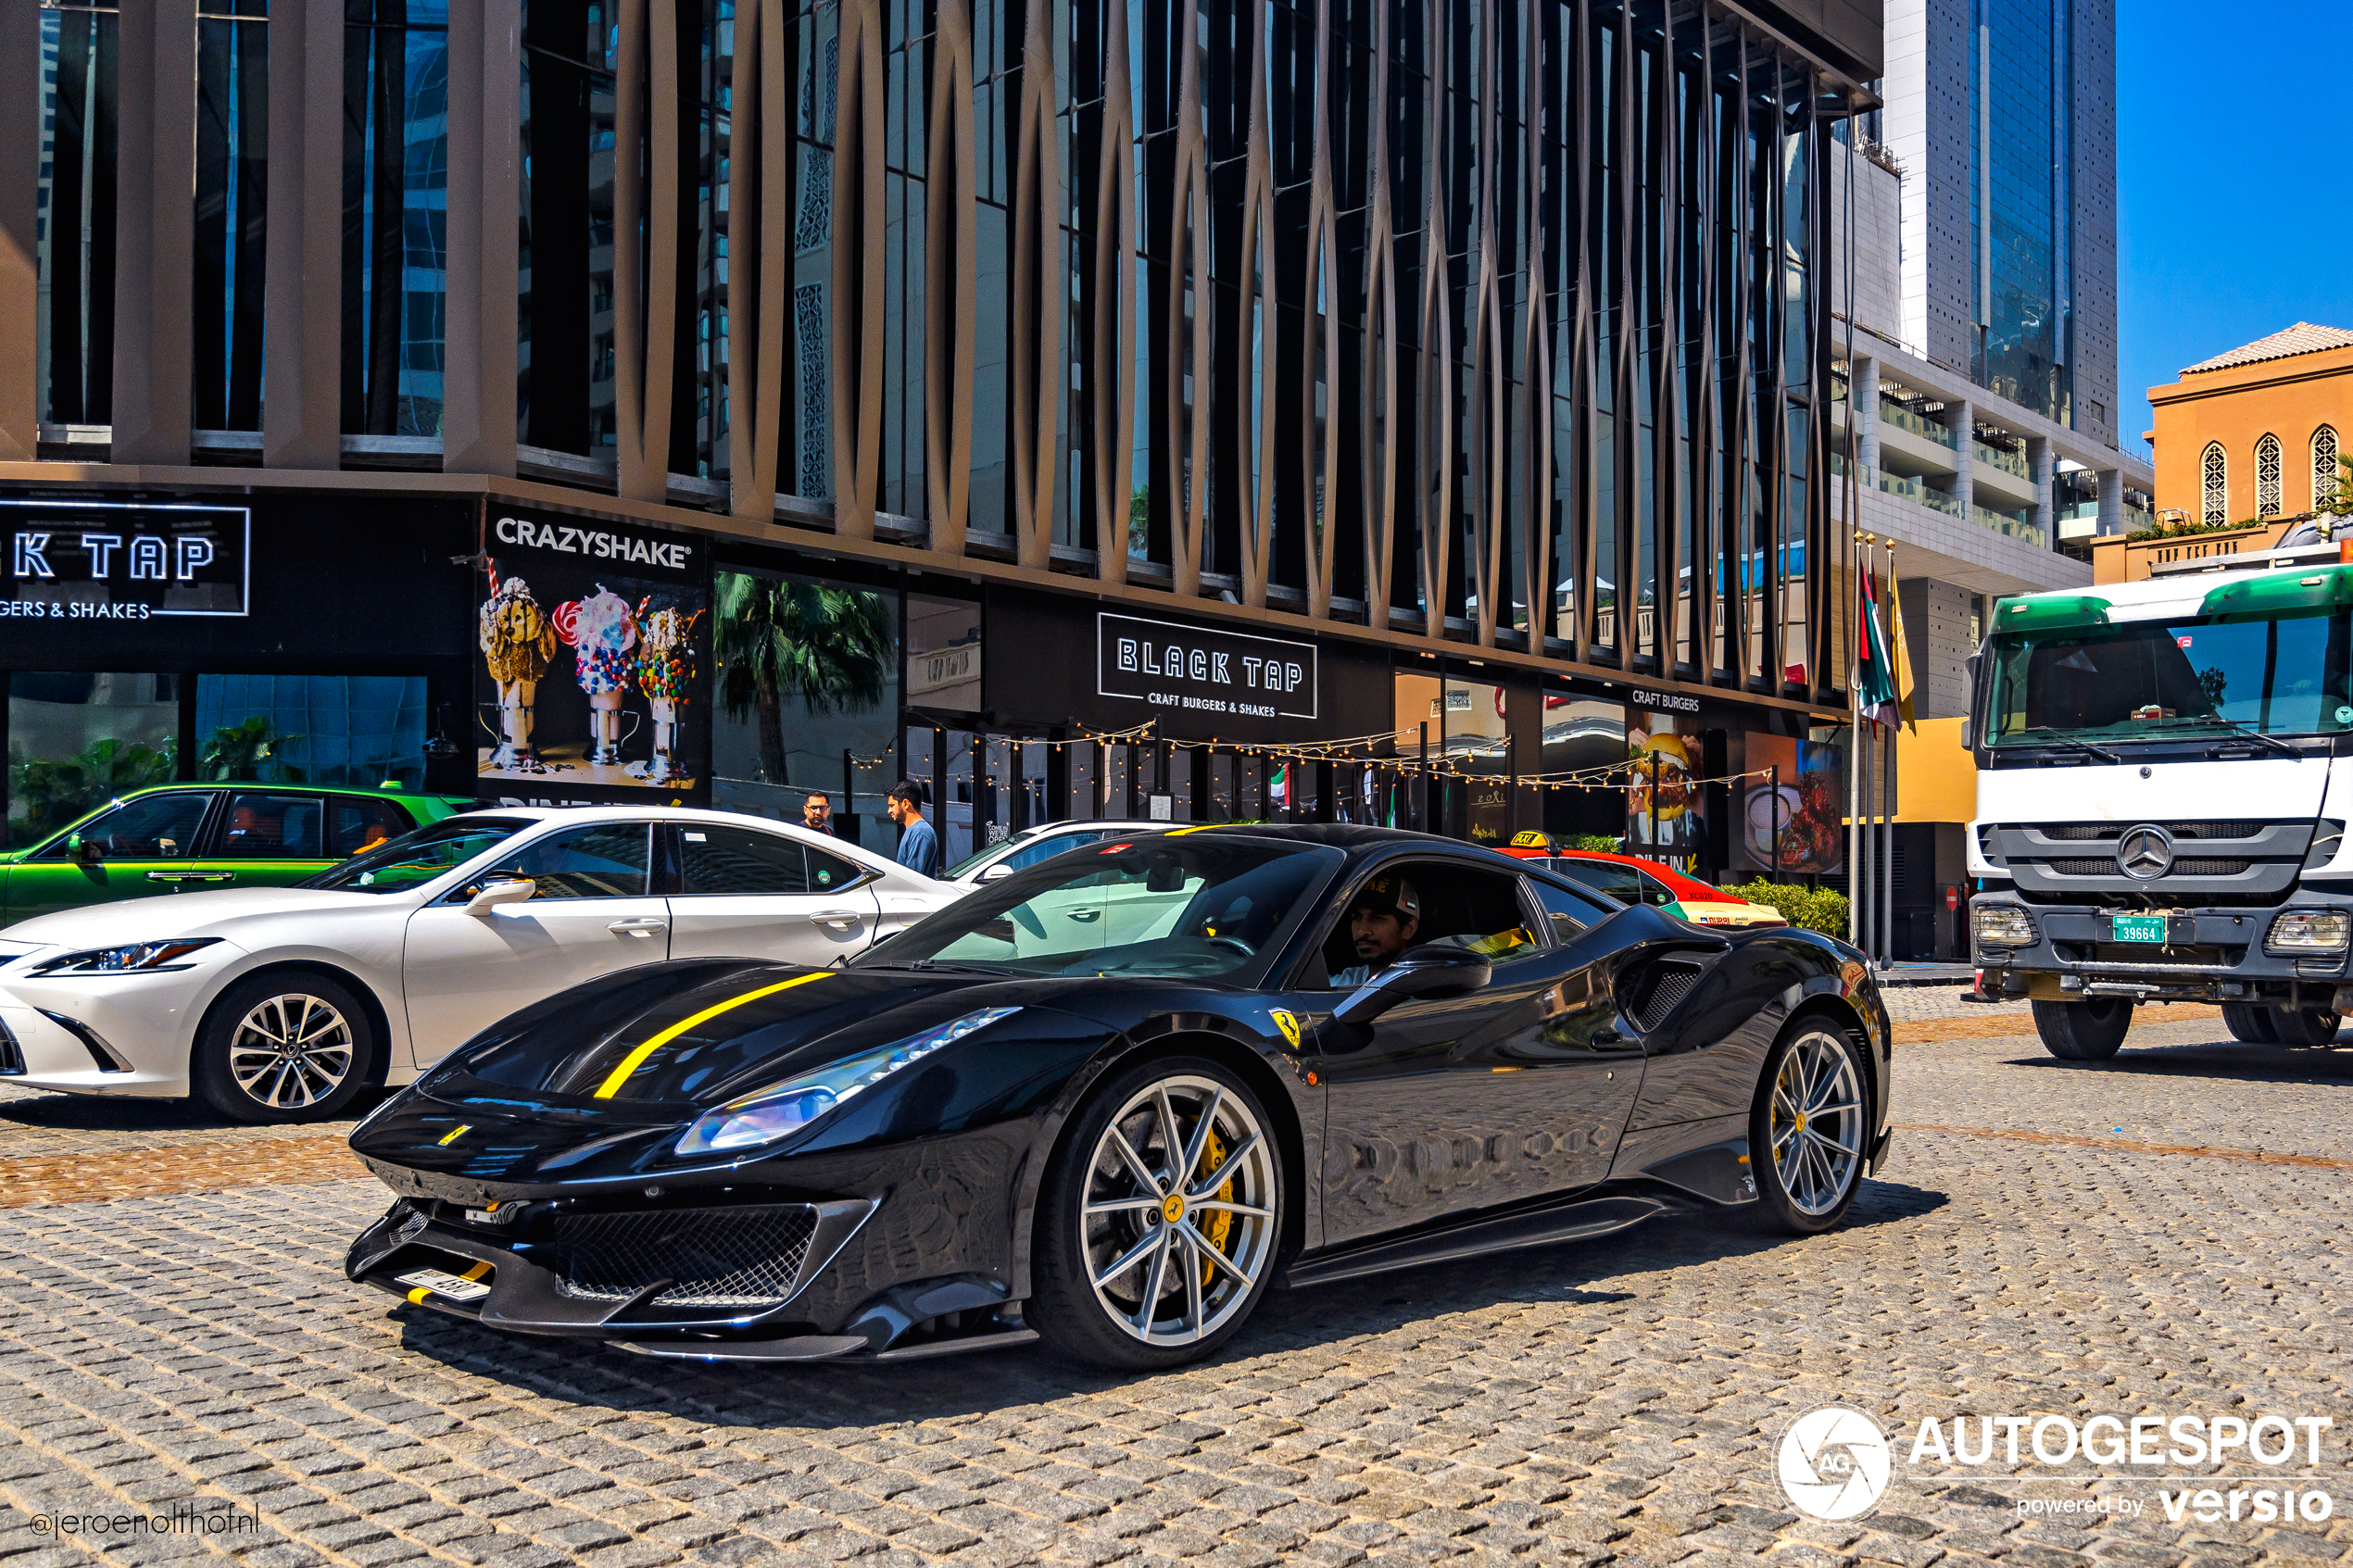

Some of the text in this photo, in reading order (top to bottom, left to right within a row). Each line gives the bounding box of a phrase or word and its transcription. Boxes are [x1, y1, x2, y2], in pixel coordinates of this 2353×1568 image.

[82, 534, 214, 580] TAP
[50, 603, 64, 618] &
[69, 603, 150, 620] SHAKES
[1117, 637, 1302, 692] BLACK TAP
[1148, 693, 1275, 718] CRAFT BURGERS & SHAKES
[1633, 690, 1700, 712] CRAFT BURGERS
[1514, 834, 1533, 844] TAXI
[1689, 892, 1713, 900] XC820
[2123, 927, 2156, 940] 39664
